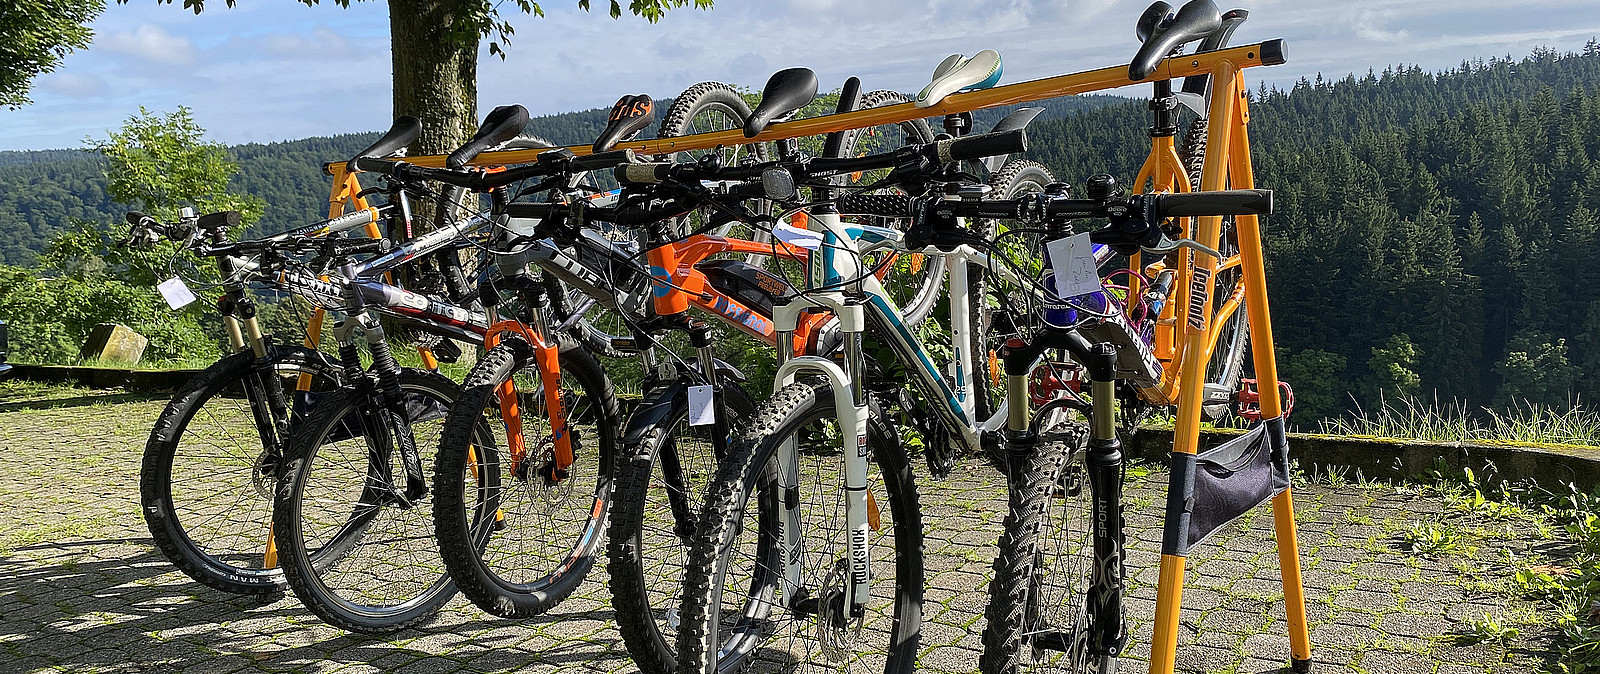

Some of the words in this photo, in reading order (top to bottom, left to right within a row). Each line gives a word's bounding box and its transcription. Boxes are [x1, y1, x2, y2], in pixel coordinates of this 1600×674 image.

[1187, 265, 1211, 331] IceToolz
[1098, 496, 1107, 538] SPORT
[851, 528, 867, 585] ROCKSHOX
